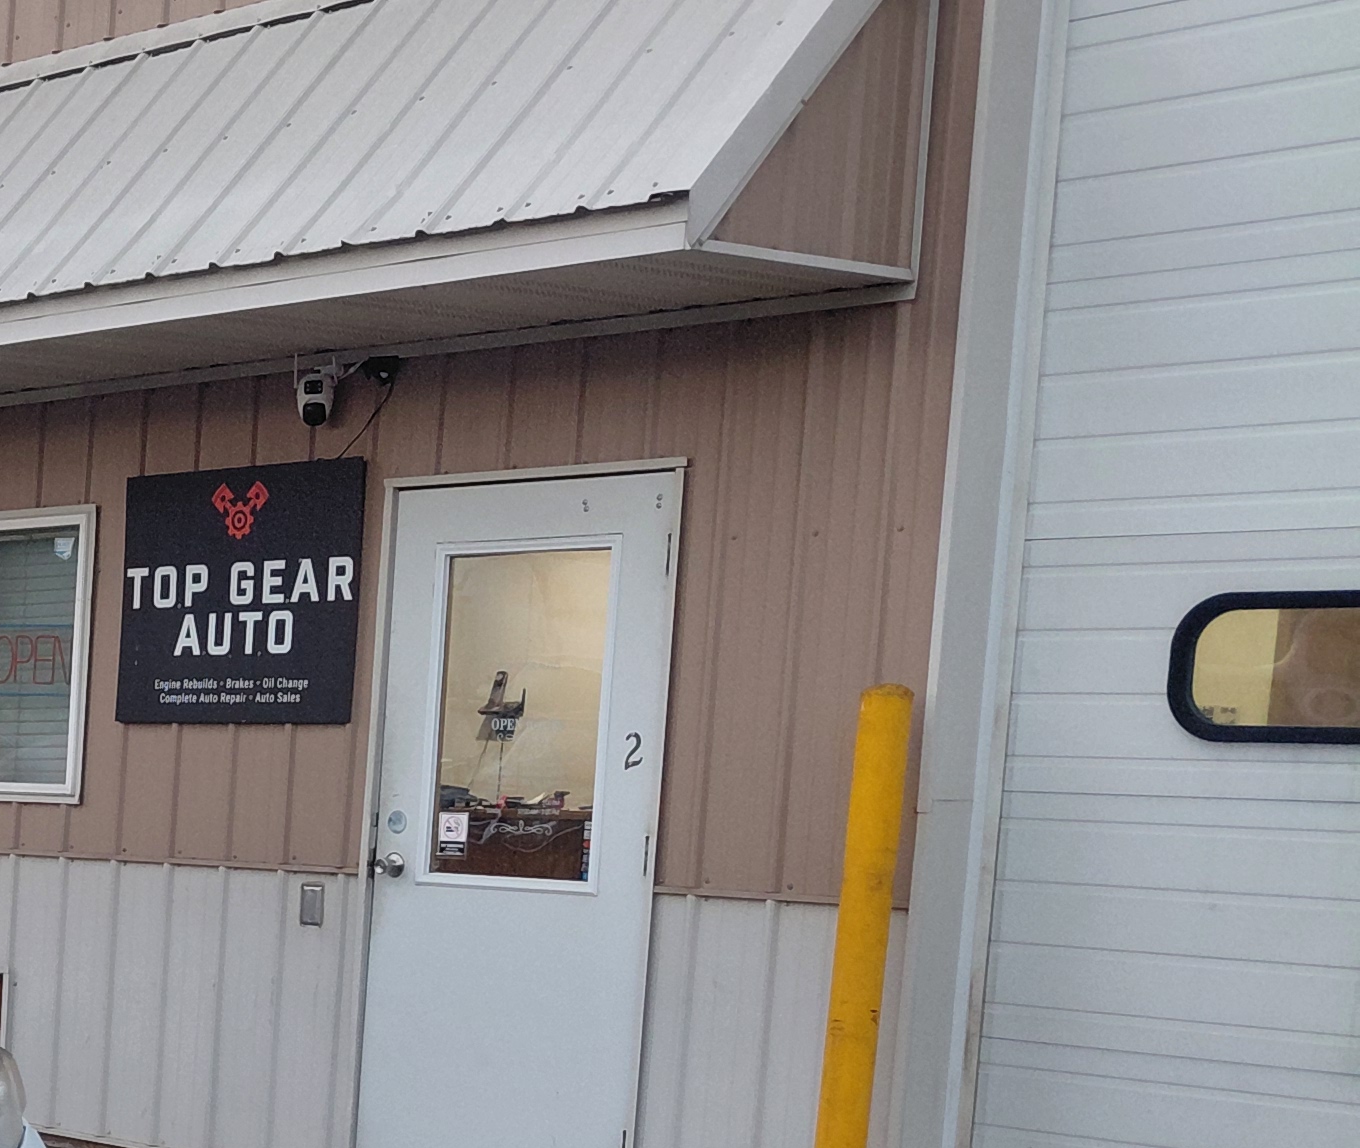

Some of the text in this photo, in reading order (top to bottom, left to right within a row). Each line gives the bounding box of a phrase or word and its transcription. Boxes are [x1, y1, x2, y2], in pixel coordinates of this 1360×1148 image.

[126, 556, 354, 610] TOP GEAR
[173, 609, 294, 657] AUTO
[154, 677, 309, 691] Engine Rebuilds Brakes Oil Change
[159, 692, 301, 705] Complete Auto Repair Auto Sales
[624, 731, 644, 771] 2
